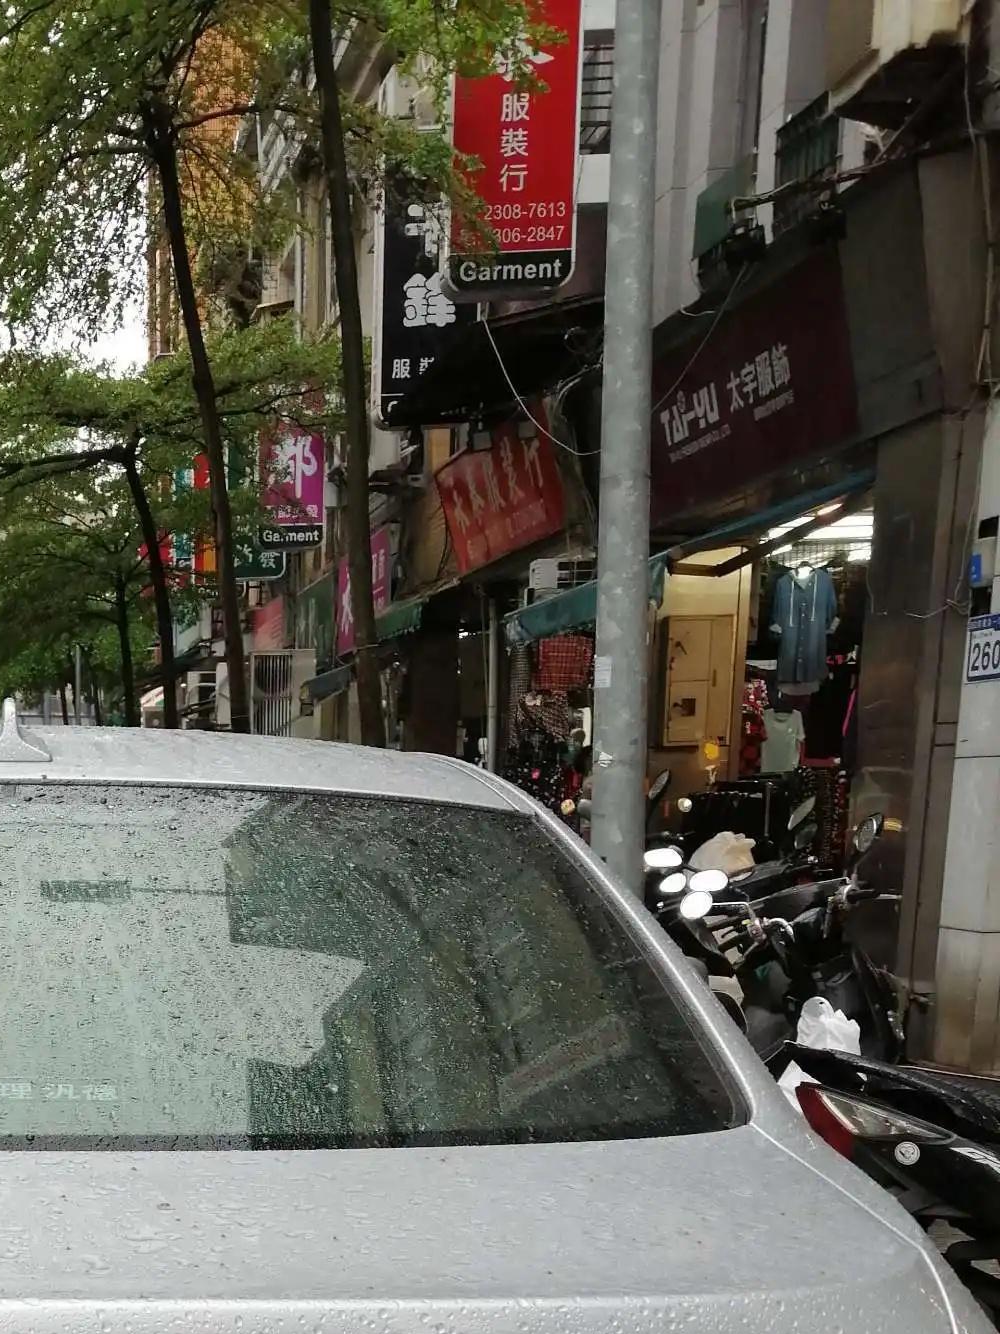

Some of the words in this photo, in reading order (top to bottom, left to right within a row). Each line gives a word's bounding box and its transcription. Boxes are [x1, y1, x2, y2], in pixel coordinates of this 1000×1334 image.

[499, 93, 530, 193] 服裝行
[484, 202, 566, 221] 2308-7613
[490, 226, 564, 244] 306-2847
[459, 257, 563, 283] Garment
